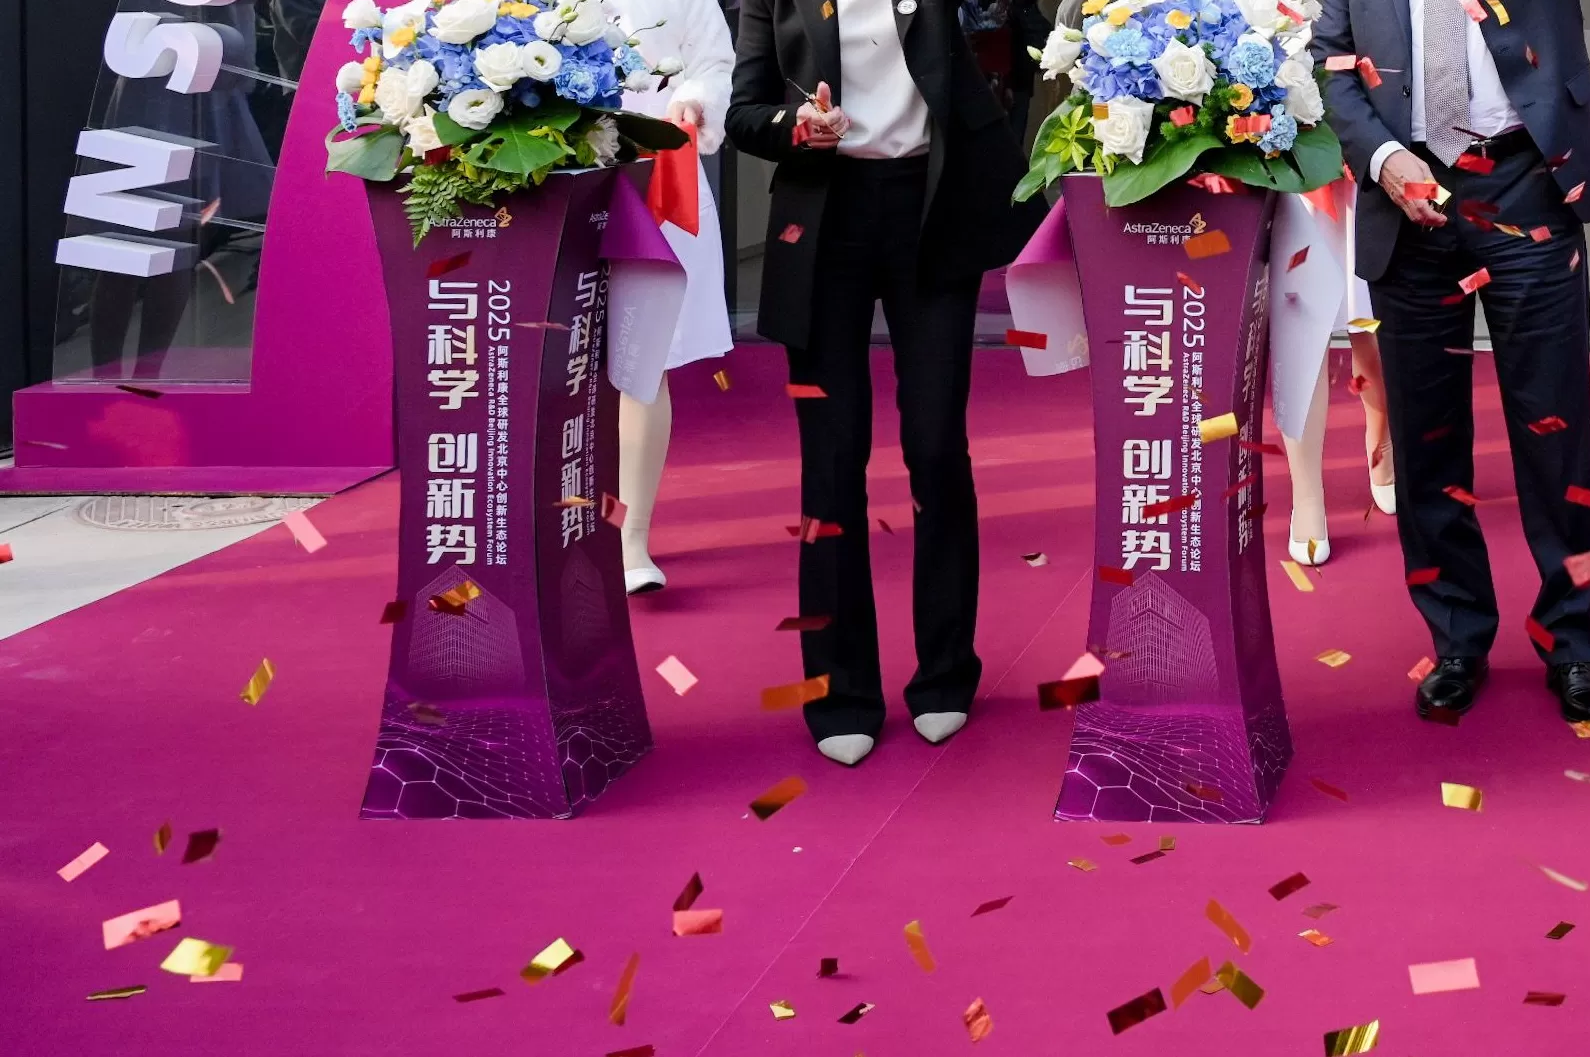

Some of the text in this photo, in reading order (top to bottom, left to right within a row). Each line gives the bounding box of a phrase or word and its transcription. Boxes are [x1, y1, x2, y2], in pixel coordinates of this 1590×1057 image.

[56, 127, 196, 277] IN
[1123, 222, 1192, 234] AstraZeneca
[451, 228, 497, 239] 阿斯利康
[566, 270, 598, 397] 与科学
[1182, 285, 1205, 348] 2025
[487, 346, 495, 397] AstraZeneca
[426, 279, 479, 565] 与科学 创新势
[487, 279, 511, 565] 2025 阿斯利康全球研发北京中心创新生态论坛
[1122, 285, 1173, 571] 与科学 创新势
[1180, 425, 1190, 454] Beijing
[486, 495, 494, 538] Ecosystem
[1180, 507, 1188, 544] osystem
